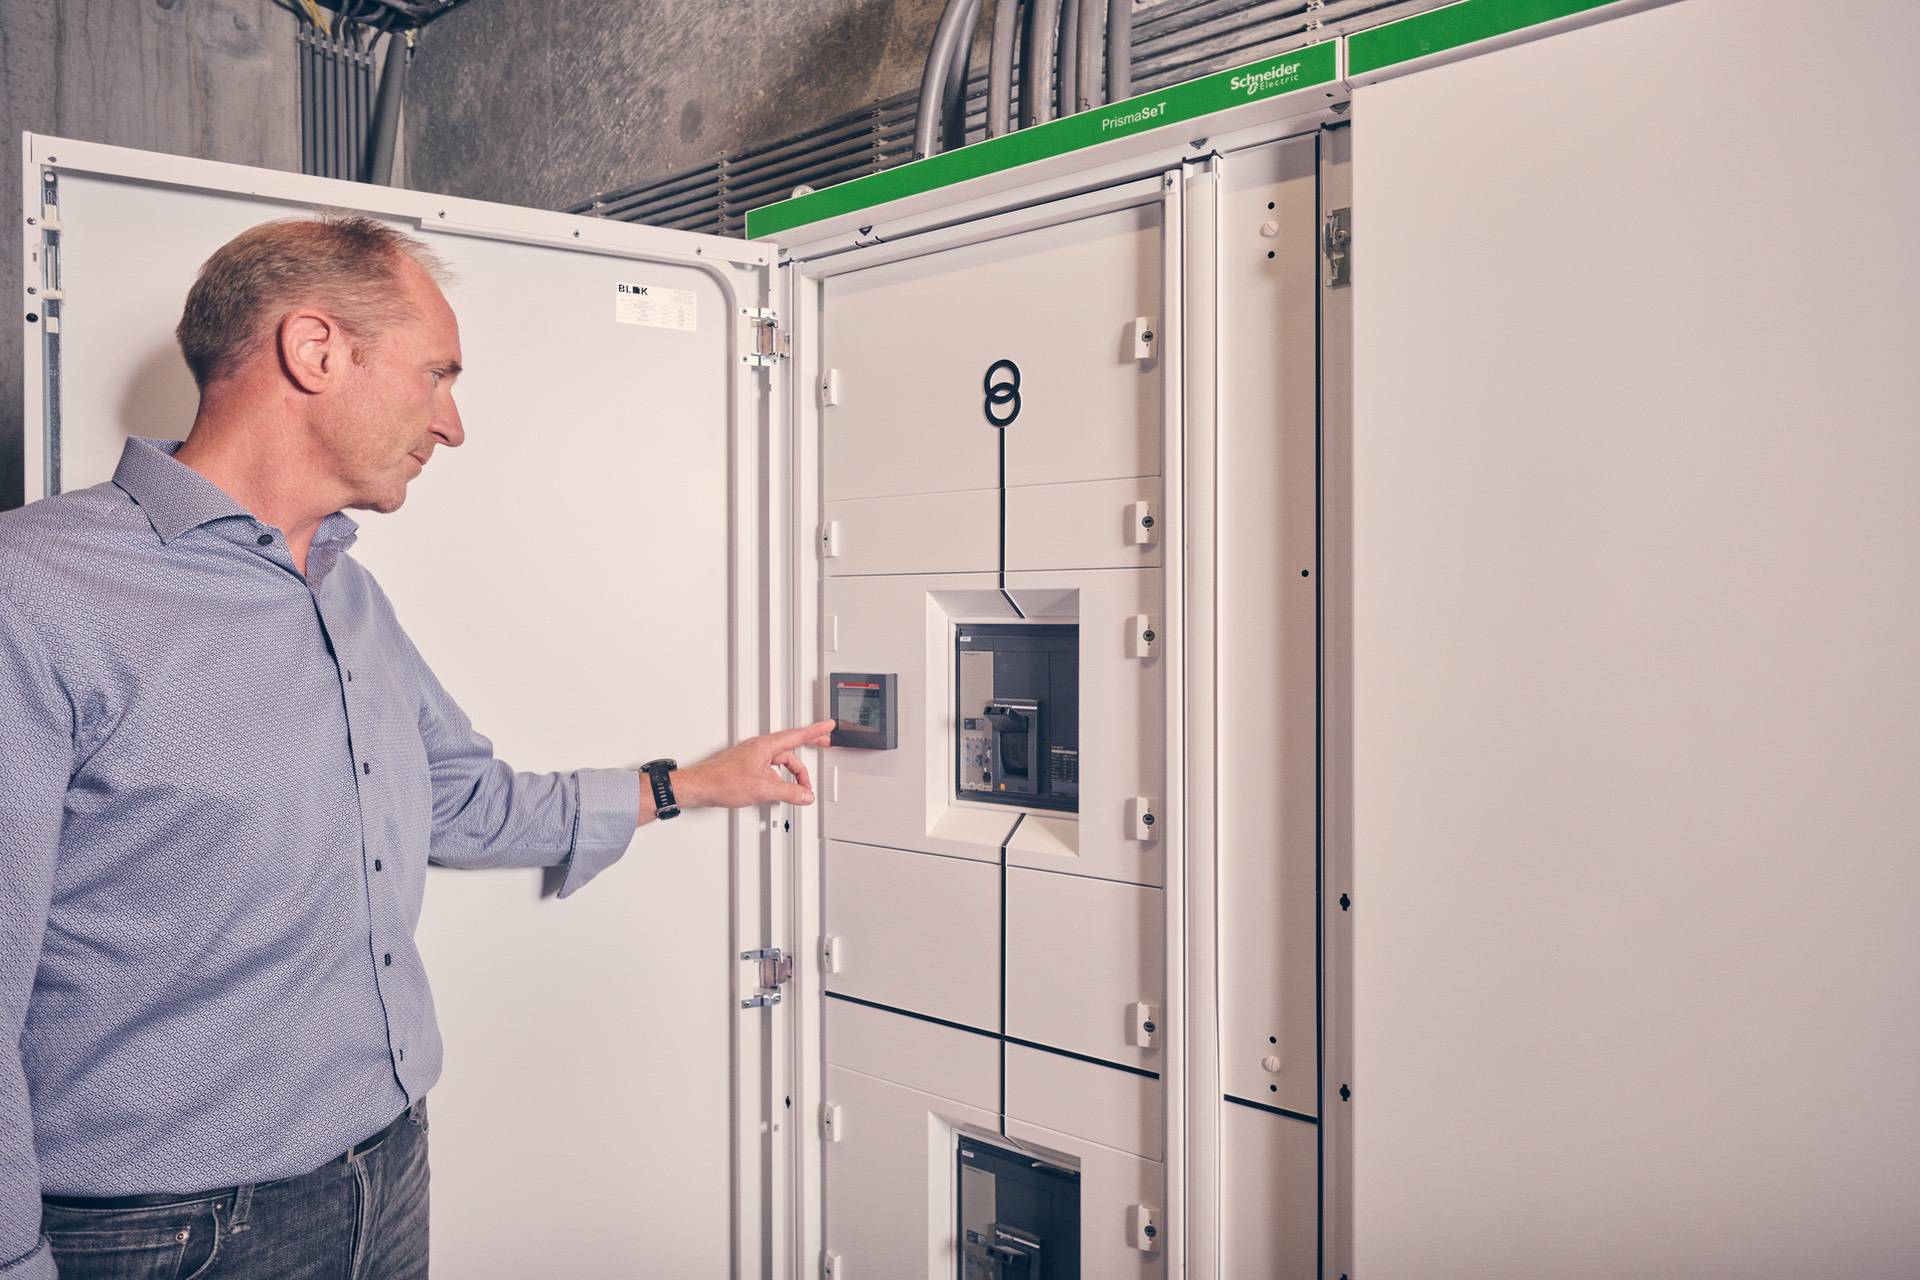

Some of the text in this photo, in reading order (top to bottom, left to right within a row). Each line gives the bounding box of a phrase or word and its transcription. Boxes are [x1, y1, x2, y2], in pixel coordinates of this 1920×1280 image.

[1230, 63, 1300, 93] Schneider
[1259, 74, 1299, 91] Electric
[1102, 102, 1167, 131] PrismaSeT
